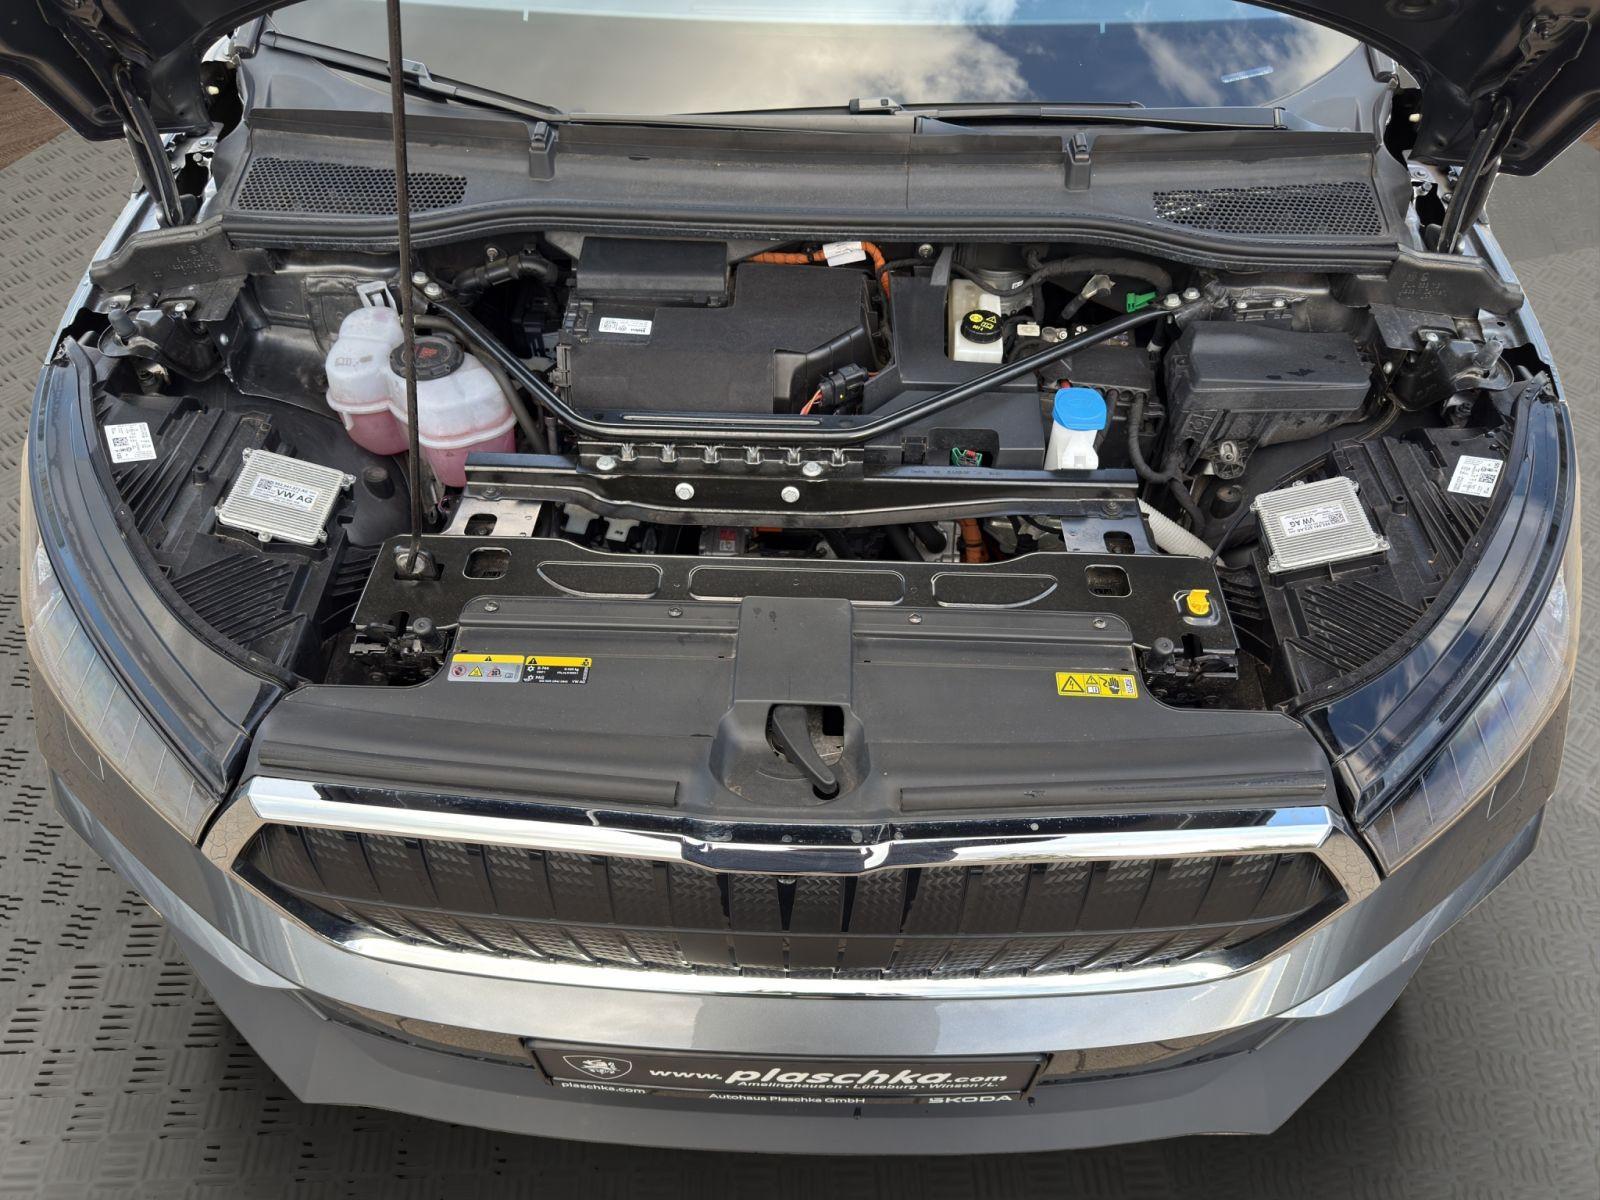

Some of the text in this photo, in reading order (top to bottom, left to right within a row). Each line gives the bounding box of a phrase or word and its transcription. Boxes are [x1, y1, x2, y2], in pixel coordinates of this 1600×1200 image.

[277, 489, 295, 499] VW
[296, 495, 313, 504] AG
[561, 1081, 646, 1095] plaschka.com
[737, 1080, 843, 1090] Amelinghausen
[852, 1083, 918, 1091] Lüneburg
[708, 1092, 866, 1104] Autohaus Plaschka GmbH
